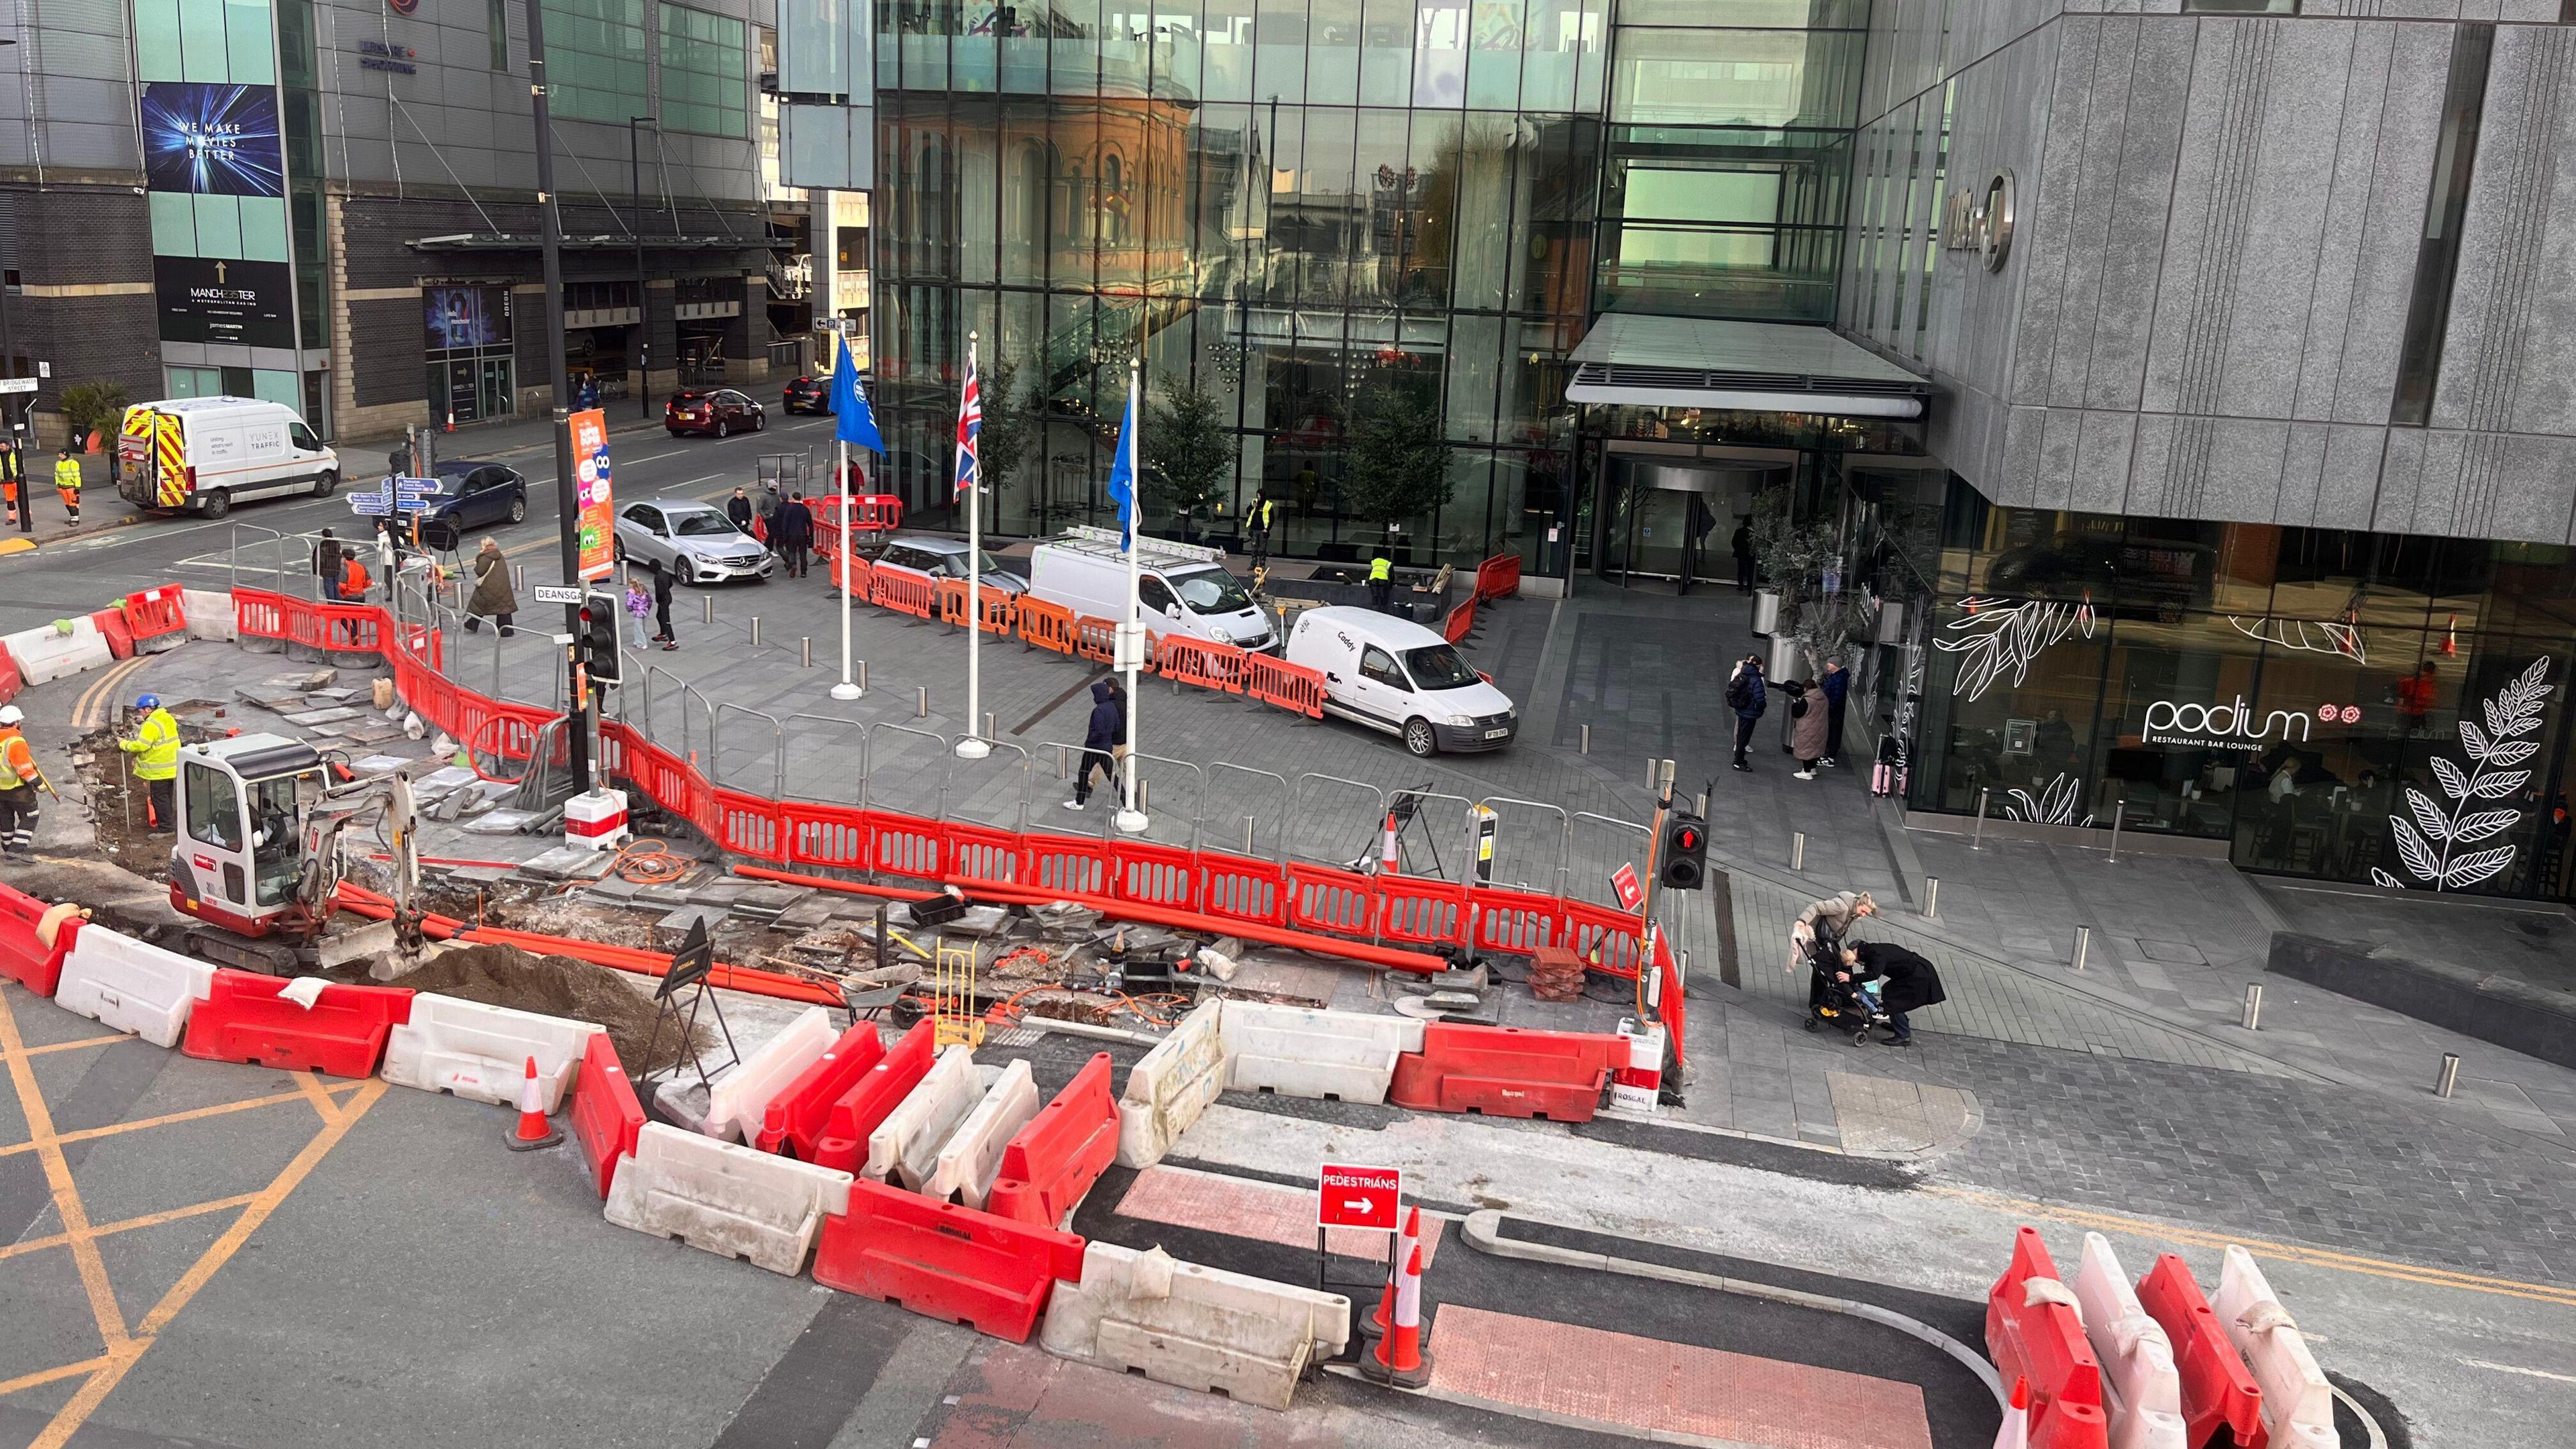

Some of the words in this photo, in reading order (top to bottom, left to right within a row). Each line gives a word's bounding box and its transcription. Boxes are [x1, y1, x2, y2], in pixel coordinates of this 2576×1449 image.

[180, 123, 197, 132] WE
[205, 123, 240, 134] MAKE
[189, 149, 235, 160] BETTER
[249, 431, 279, 441] YUNEX
[252, 441, 280, 449] TRAFFIC
[1338, 631, 1356, 652] Caddy
[2143, 694, 2309, 743] podium
[2152, 736, 2205, 747] RESTAURANT
[2208, 740, 2224, 748] BAR
[2226, 742, 2263, 751] LOUNGE
[1617, 1092, 1646, 1104] ROSGAL
[1323, 1174, 1397, 1190] PEDESTRIANS
